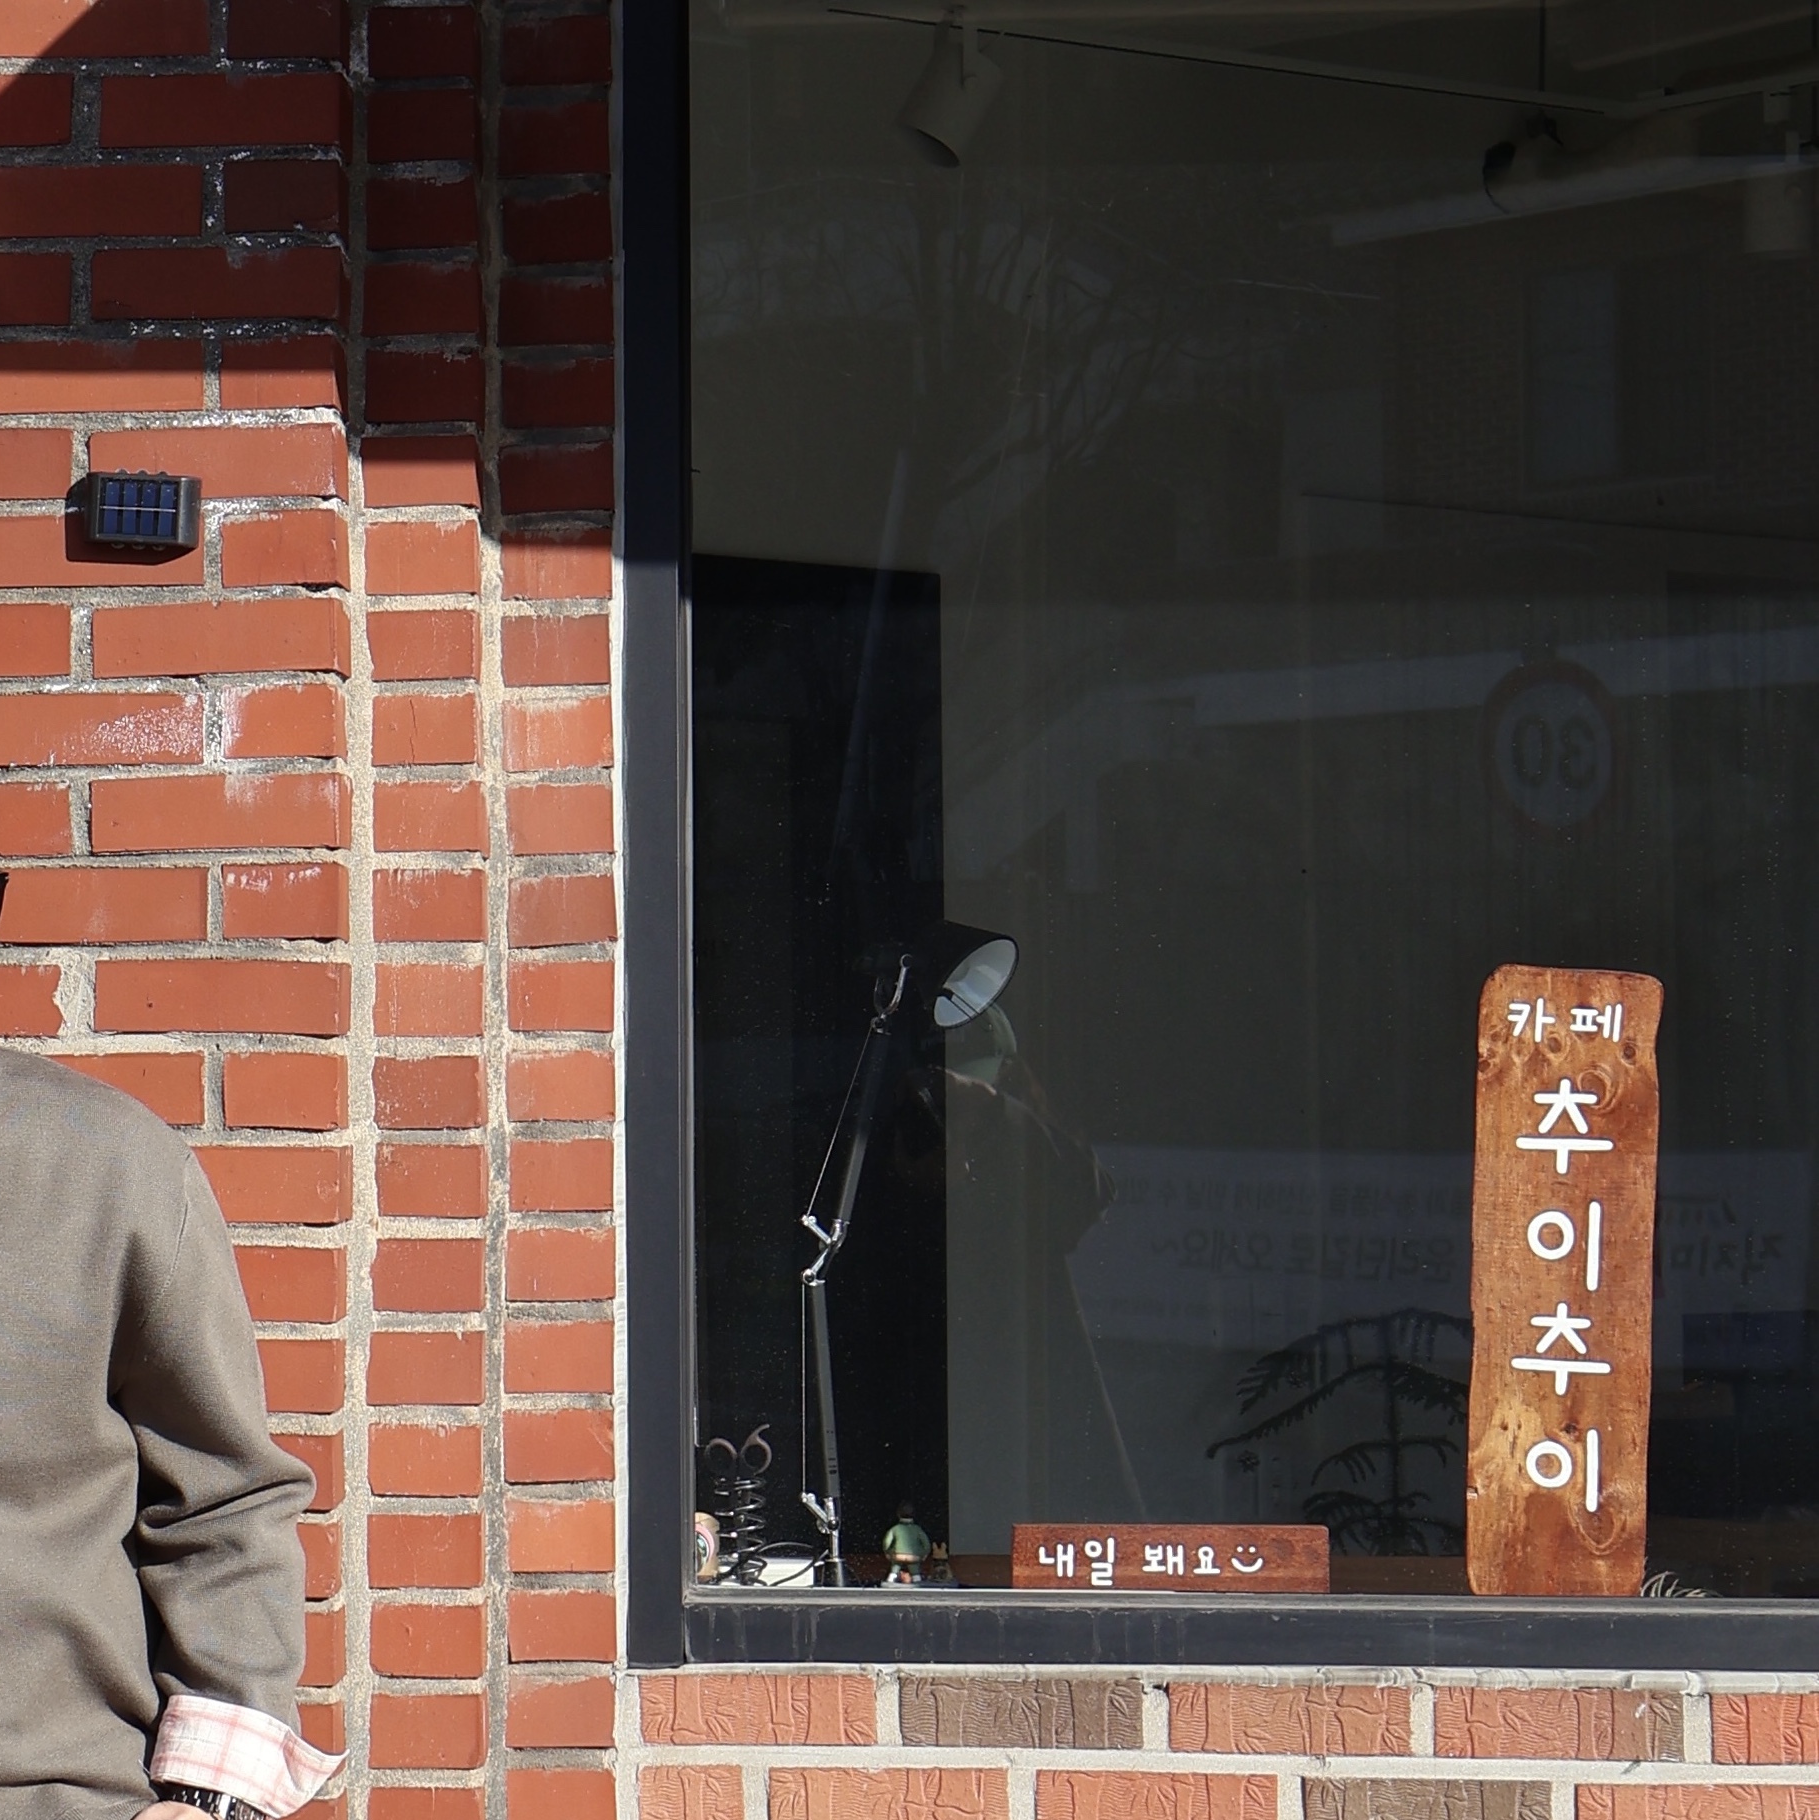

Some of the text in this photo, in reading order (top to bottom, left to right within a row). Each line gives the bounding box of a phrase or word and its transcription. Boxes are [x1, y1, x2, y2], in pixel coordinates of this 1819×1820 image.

[1506, 996, 1624, 1043] 카페
[1510, 1077, 1615, 1514] 추이추이
[1038, 1536, 1222, 1587] 내일 봬요
